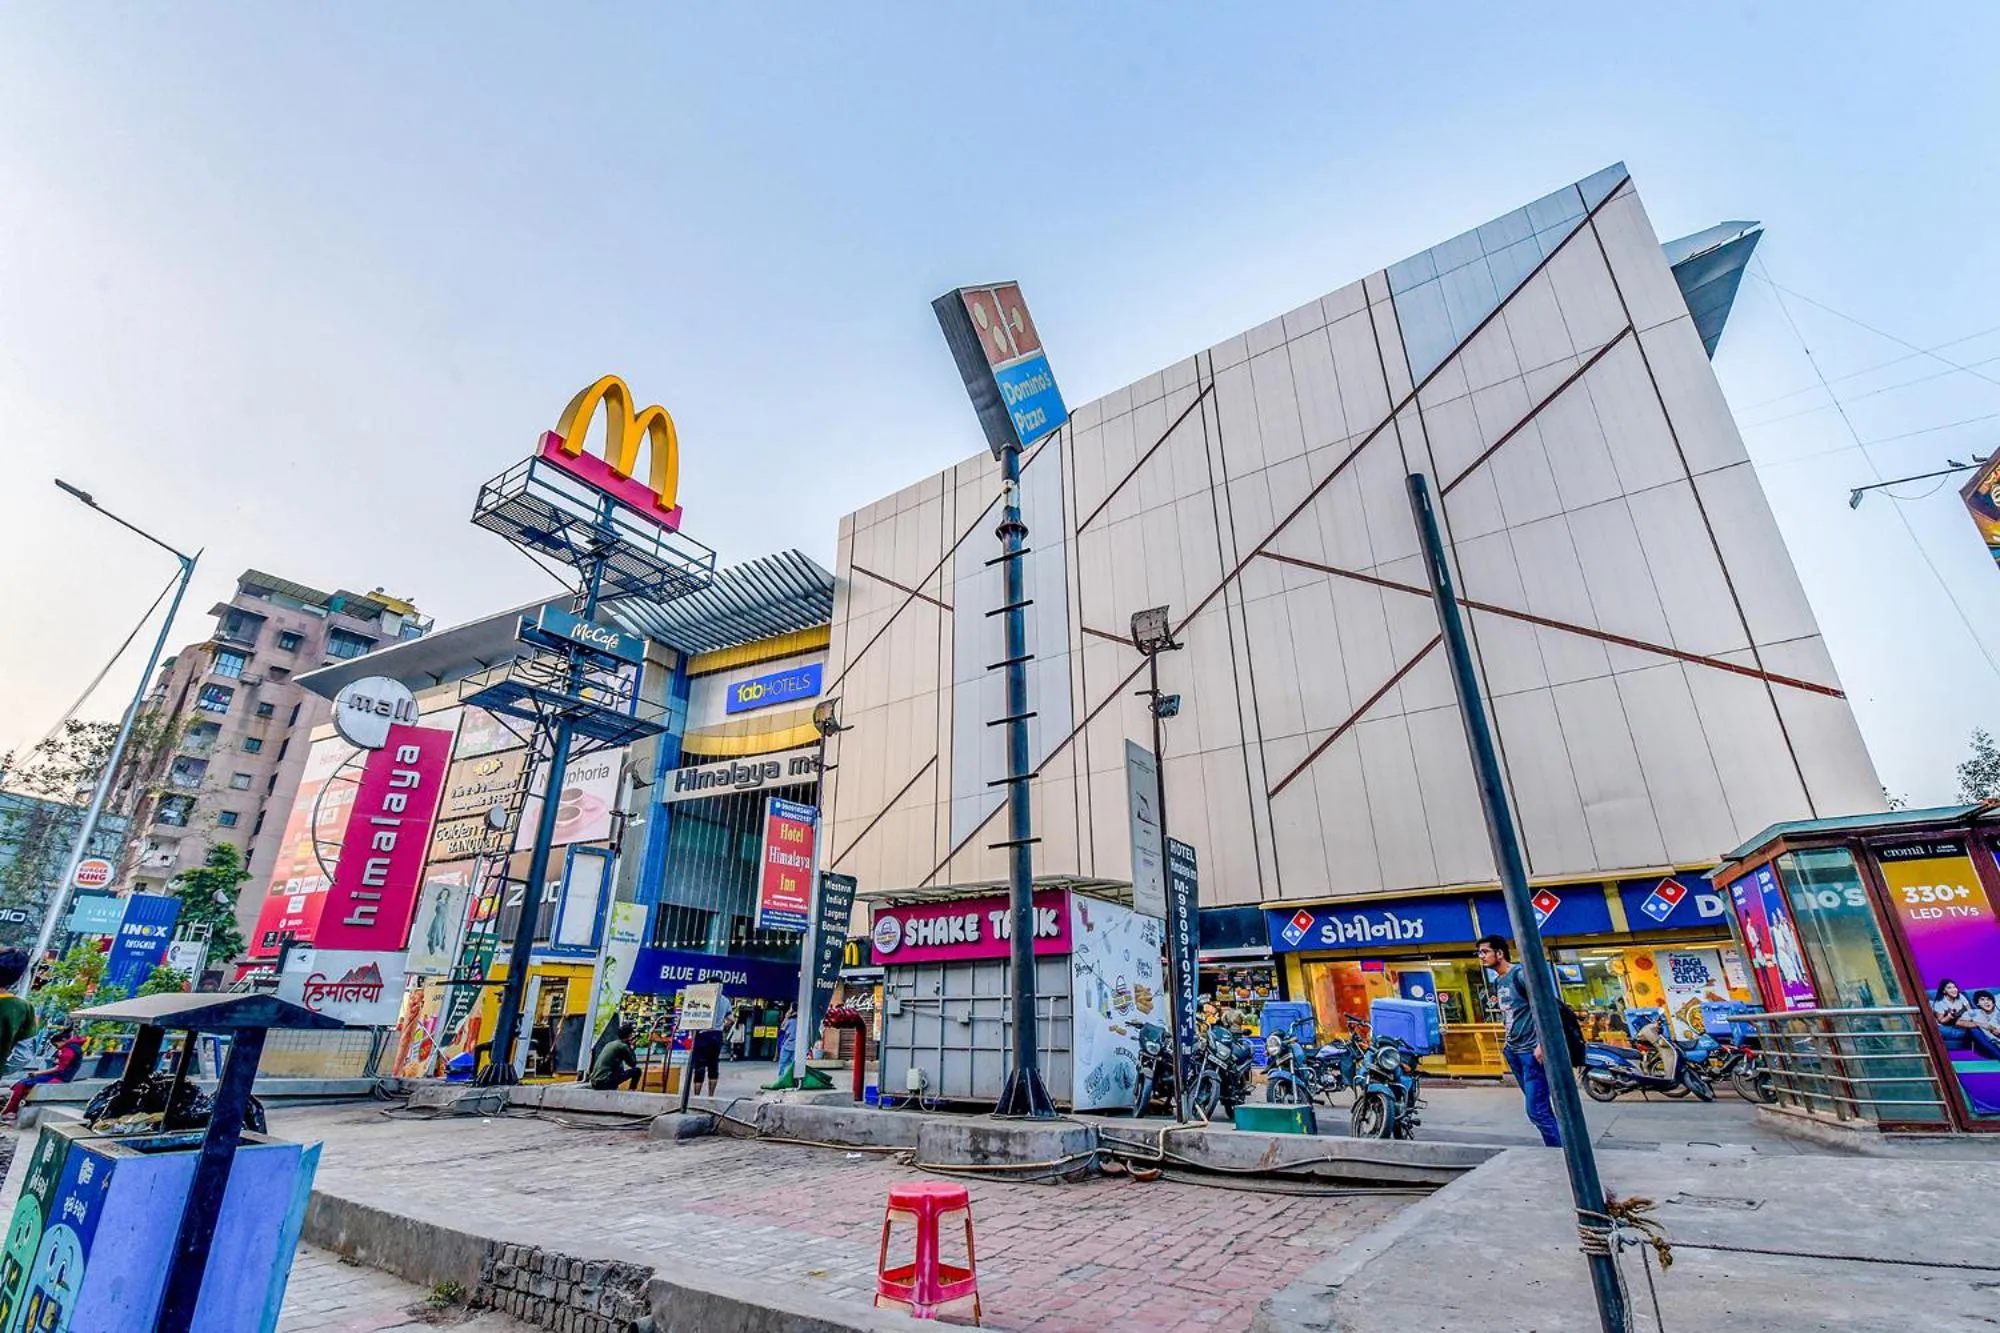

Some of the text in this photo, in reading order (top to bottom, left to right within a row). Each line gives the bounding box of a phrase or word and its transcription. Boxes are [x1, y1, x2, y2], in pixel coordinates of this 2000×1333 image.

[1003, 367, 1052, 405] Domino's
[1014, 406, 1046, 435] Pizza
[736, 674, 811, 703] fabHOTELS
[350, 692, 414, 723] mall
[674, 759, 781, 793] Himalaya
[342, 744, 421, 927] himalaya
[780, 823, 804, 844] Hotel
[768, 845, 811, 873] Himalaya
[77, 872, 107, 881] KING
[780, 873, 796, 892] Inn
[1901, 884, 1970, 904] 330+
[1910, 905, 1980, 920] LED TVs
[122, 923, 169, 938] INOX
[904, 913, 981, 946] SHAKE
[1320, 912, 1424, 945] ડોમીનોઝ
[826, 936, 843, 948] Alley
[1672, 965, 1708, 976] SUPER
[1674, 958, 1702, 967] RAGI
[660, 965, 694, 981] BLUE
[1674, 974, 1710, 985] CRUST
